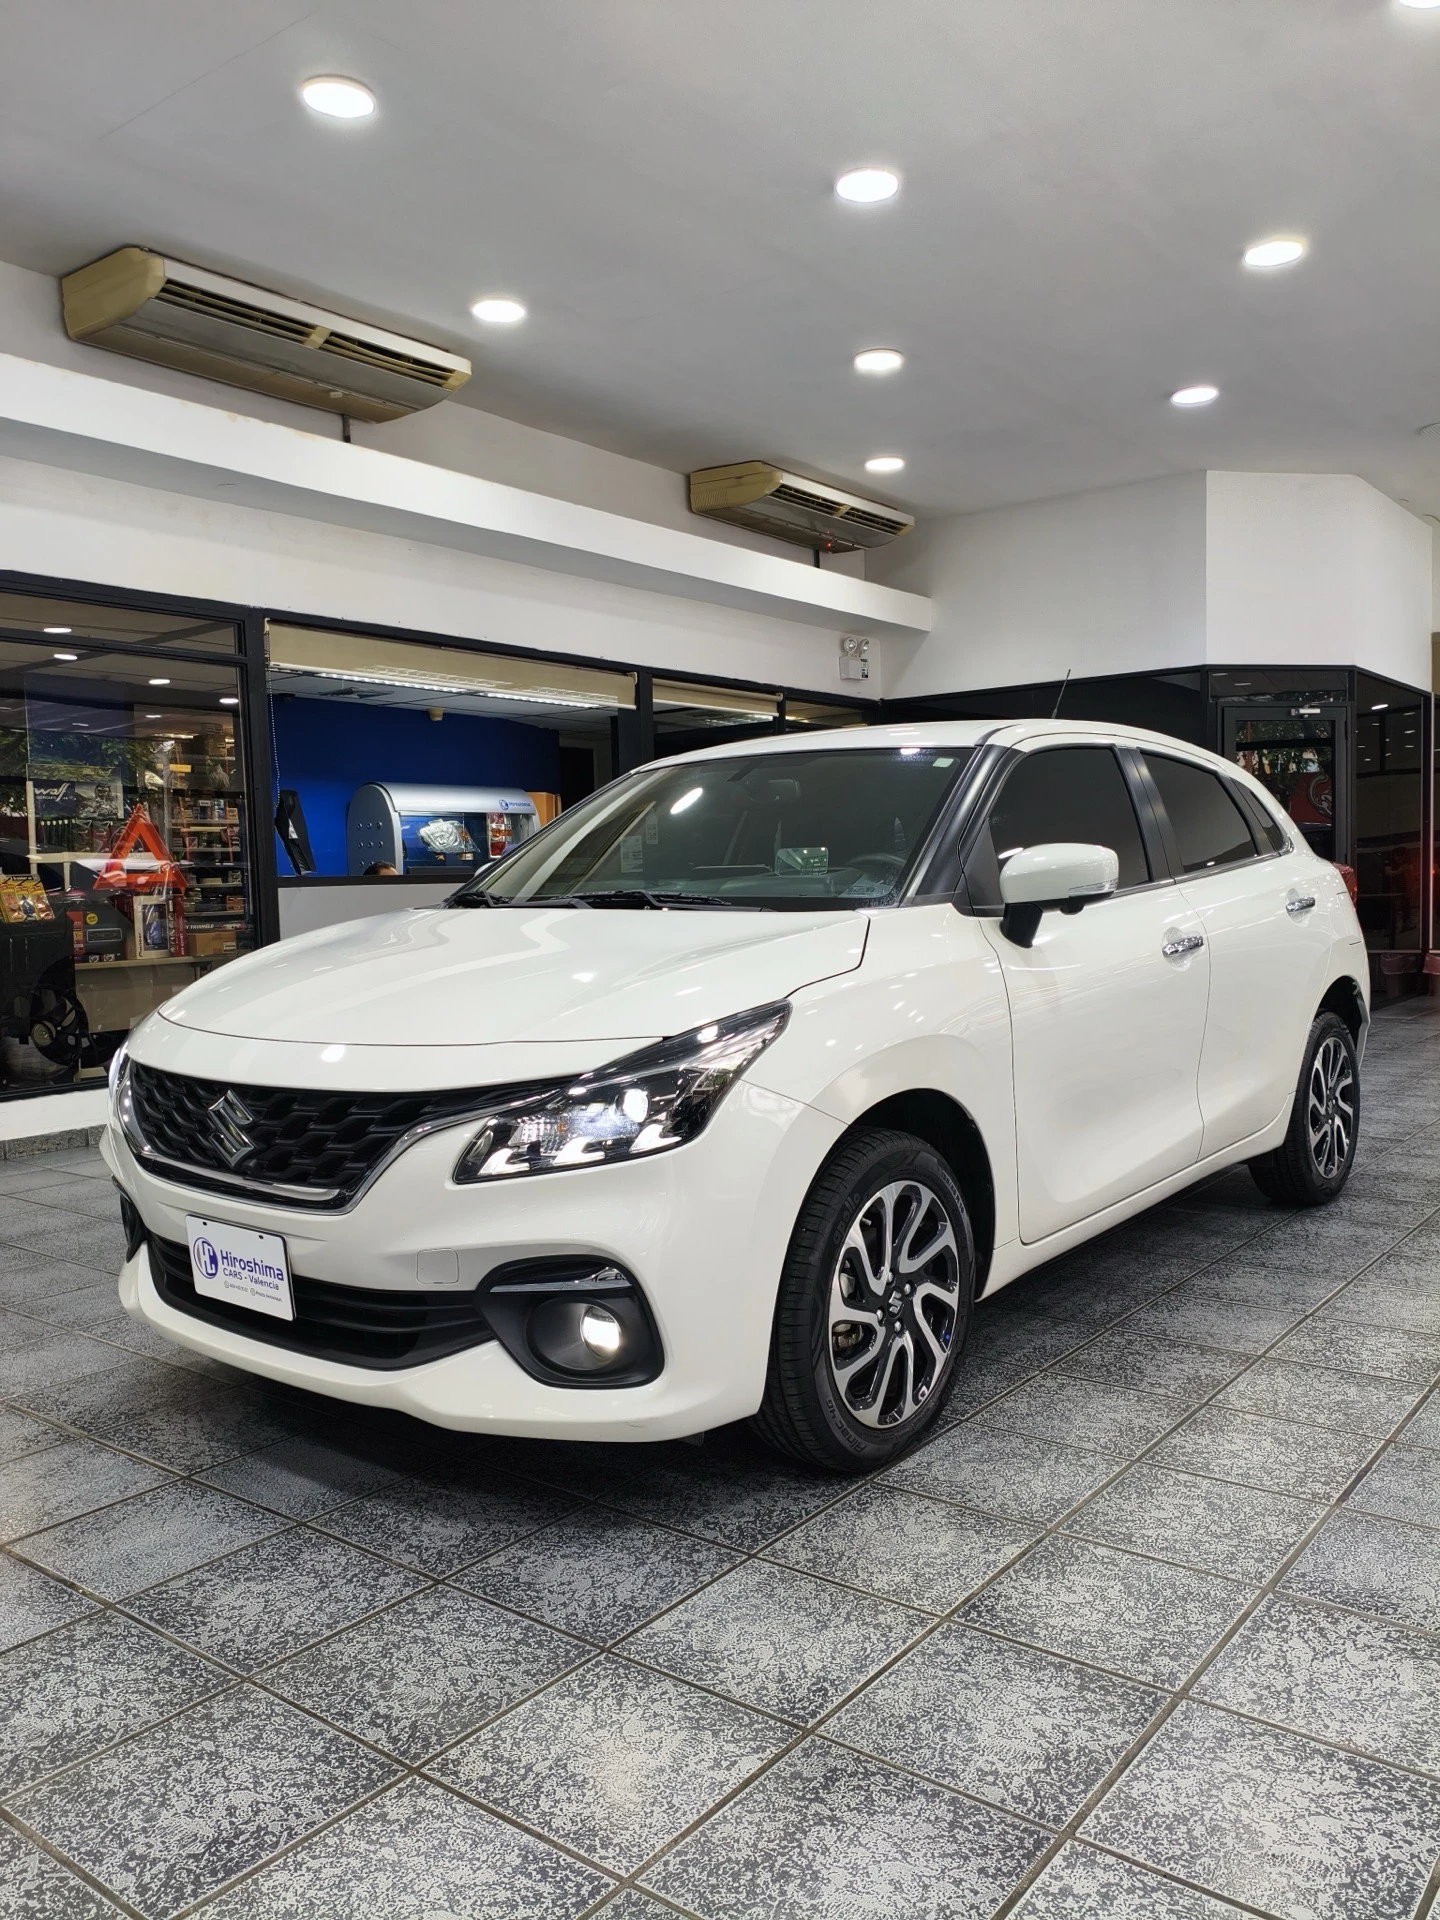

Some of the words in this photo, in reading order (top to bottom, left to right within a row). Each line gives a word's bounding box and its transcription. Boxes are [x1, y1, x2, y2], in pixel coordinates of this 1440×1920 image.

[832, 1192, 861, 1245] apollo
[220, 1249, 285, 1282] Hiroshima
[223, 1267, 243, 1281] CARS
[248, 1273, 279, 1290] Valencia
[835, 1420, 867, 1453] Alnac
